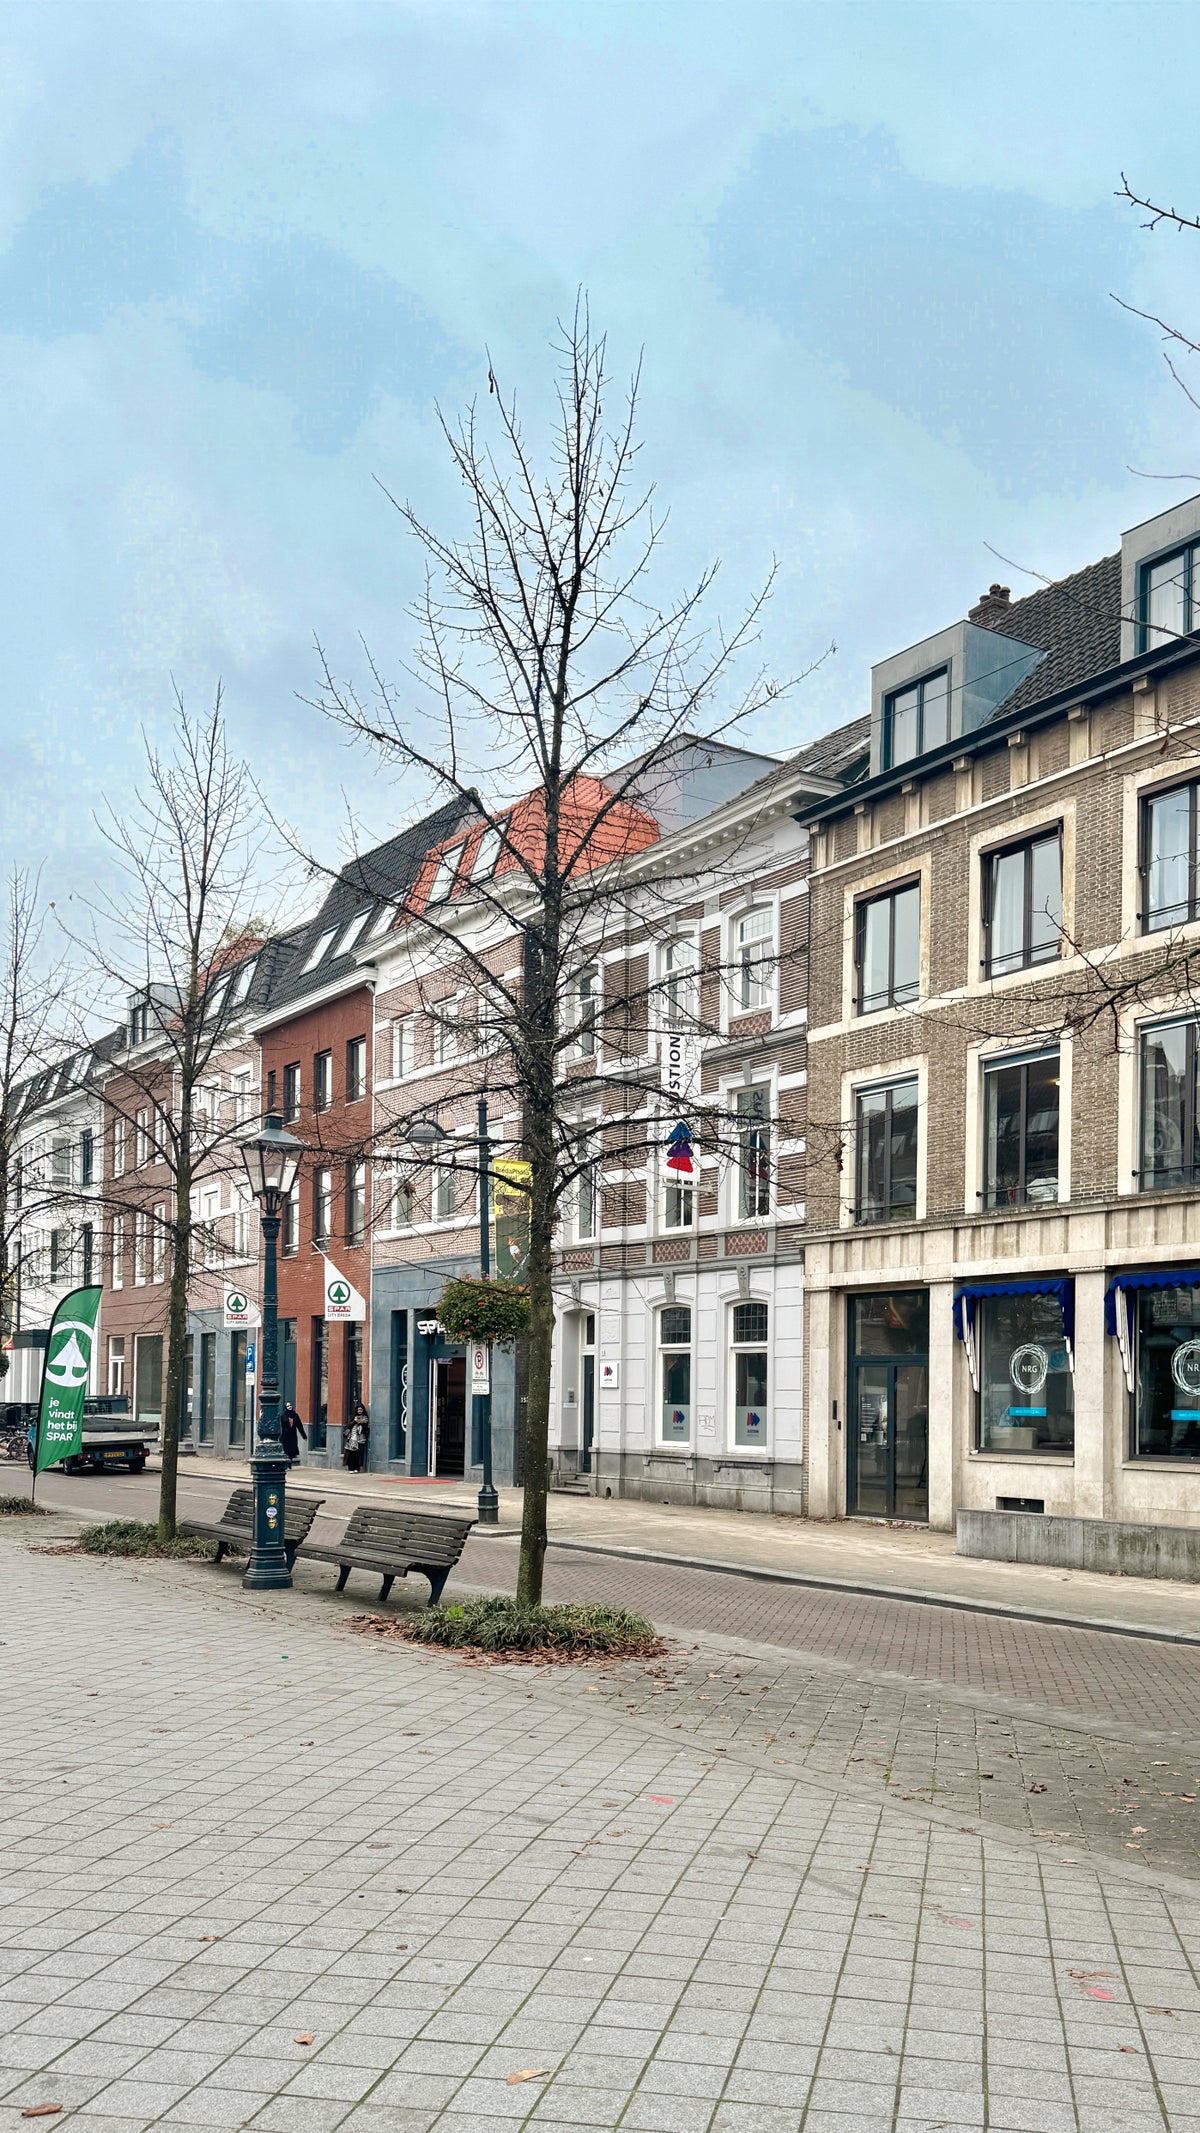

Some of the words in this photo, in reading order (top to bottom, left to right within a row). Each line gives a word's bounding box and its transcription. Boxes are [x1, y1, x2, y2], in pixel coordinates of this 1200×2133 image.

[669, 1035, 681, 1103] USTION
[417, 1319, 446, 1335] SP
[1021, 1364, 1038, 1374] NRG
[1187, 1363, 1200, 1372] NR
[48, 1397, 60, 1408] je
[48, 1409, 75, 1419] vindt
[47, 1420, 65, 1430] het
[66, 1420, 78, 1432] bij
[46, 1431, 73, 1441] SPAR
